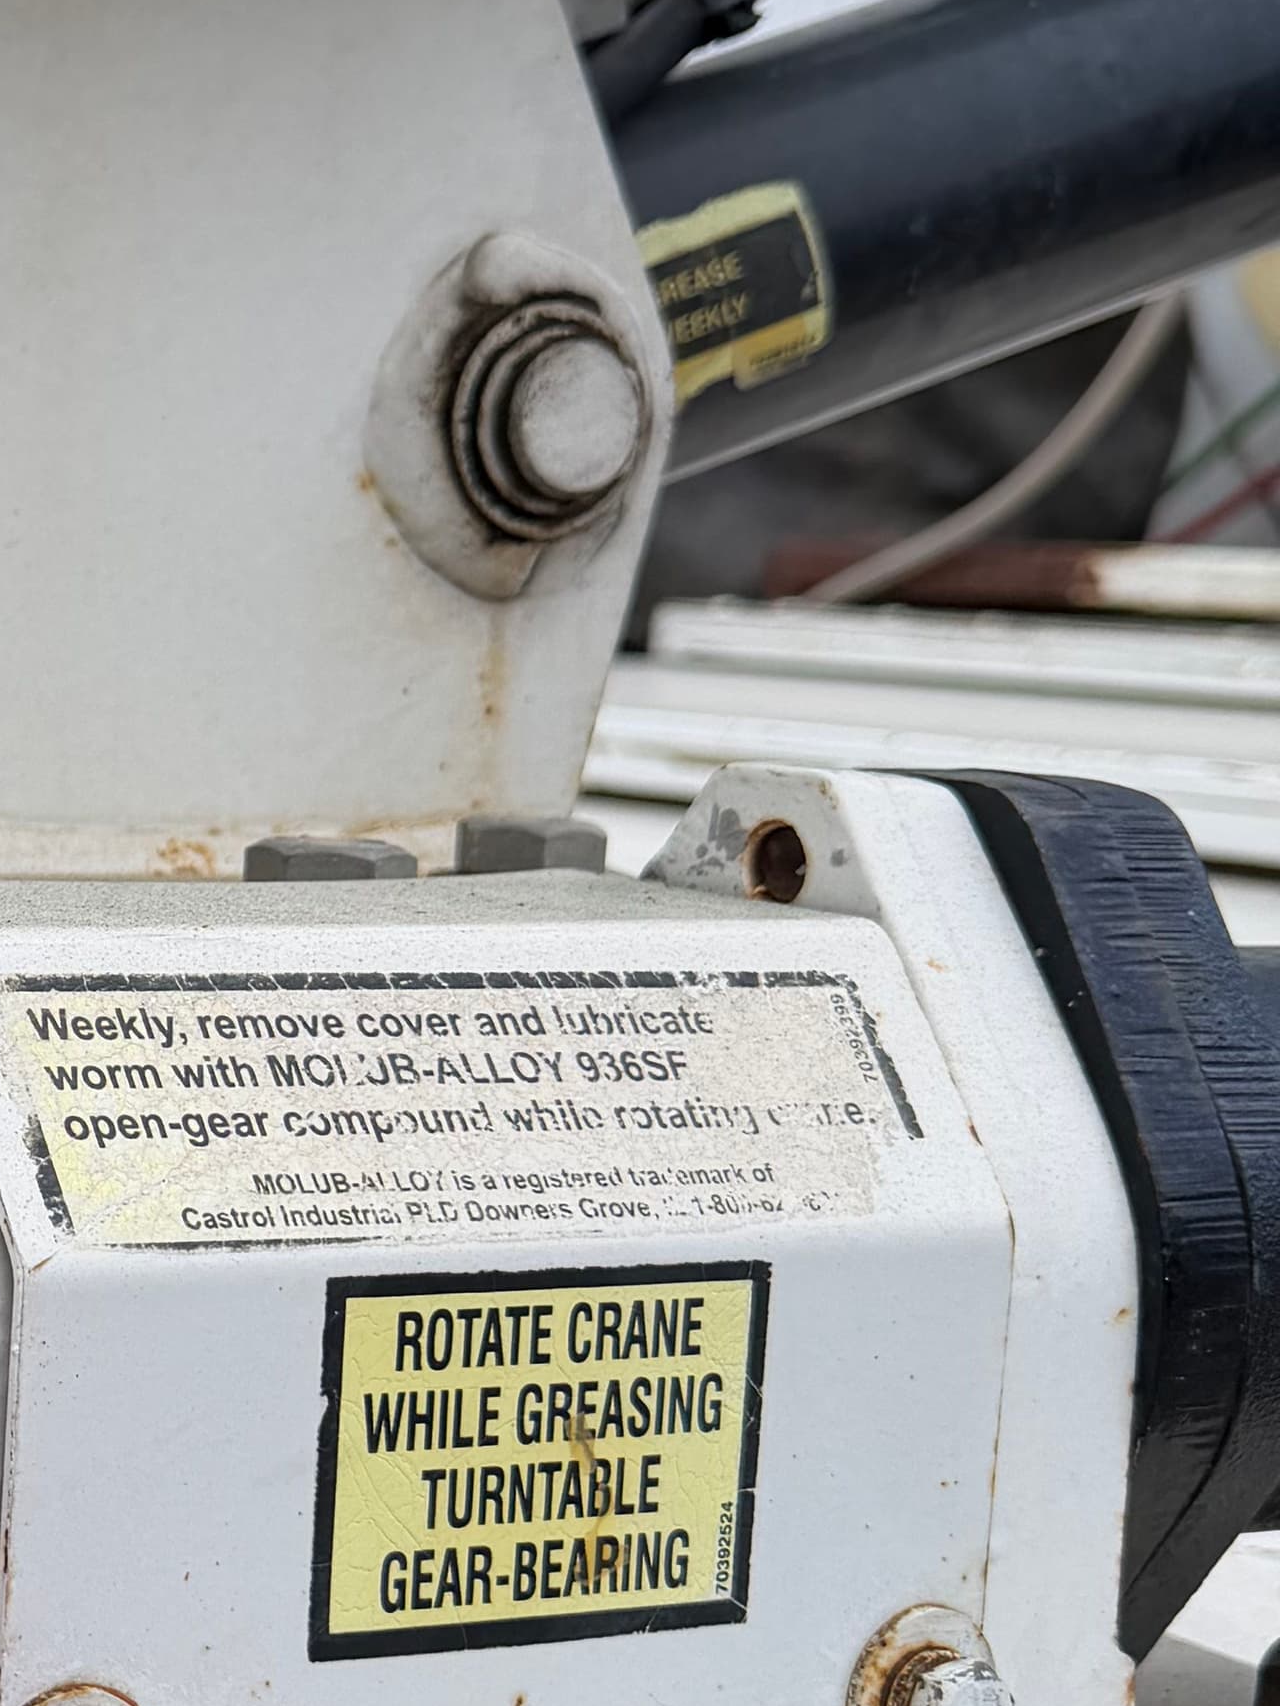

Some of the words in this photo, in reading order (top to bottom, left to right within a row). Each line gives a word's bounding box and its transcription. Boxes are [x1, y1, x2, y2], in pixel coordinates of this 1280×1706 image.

[656, 250, 744, 308] REASE
[668, 292, 747, 343] EEKLY
[26, 1007, 188, 1048] Weekly,
[197, 1012, 346, 1040] remove
[356, 1012, 461, 1038] cover
[474, 1005, 546, 1036] and
[551, 1003, 713, 1036] lubricate
[44, 1063, 164, 1091] worm
[172, 1055, 259, 1089] with
[575, 1050, 688, 1083] 936SF
[64, 1111, 269, 1149] open-gear
[283, 1099, 494, 1143] compound
[503, 1098, 605, 1132] while
[614, 1096, 760, 1136] rotating
[452, 1168, 476, 1191] is
[483, 1174, 498, 1191] a
[502, 1166, 623, 1195] registered
[752, 1162, 775, 1183] of
[181, 1204, 276, 1230] Castrol
[465, 1198, 572, 1222] Downers
[578, 1196, 660, 1220] Grove,
[394, 1304, 554, 1372] ROTATE
[566, 1297, 705, 1364] CRANE
[363, 1386, 502, 1454] WHILE
[515, 1372, 723, 1446] GREASING
[421, 1454, 662, 1530] TURNTABLE
[380, 1529, 690, 1614] GEAR-BEARING
[715, 1500, 734, 1595] 70392524
